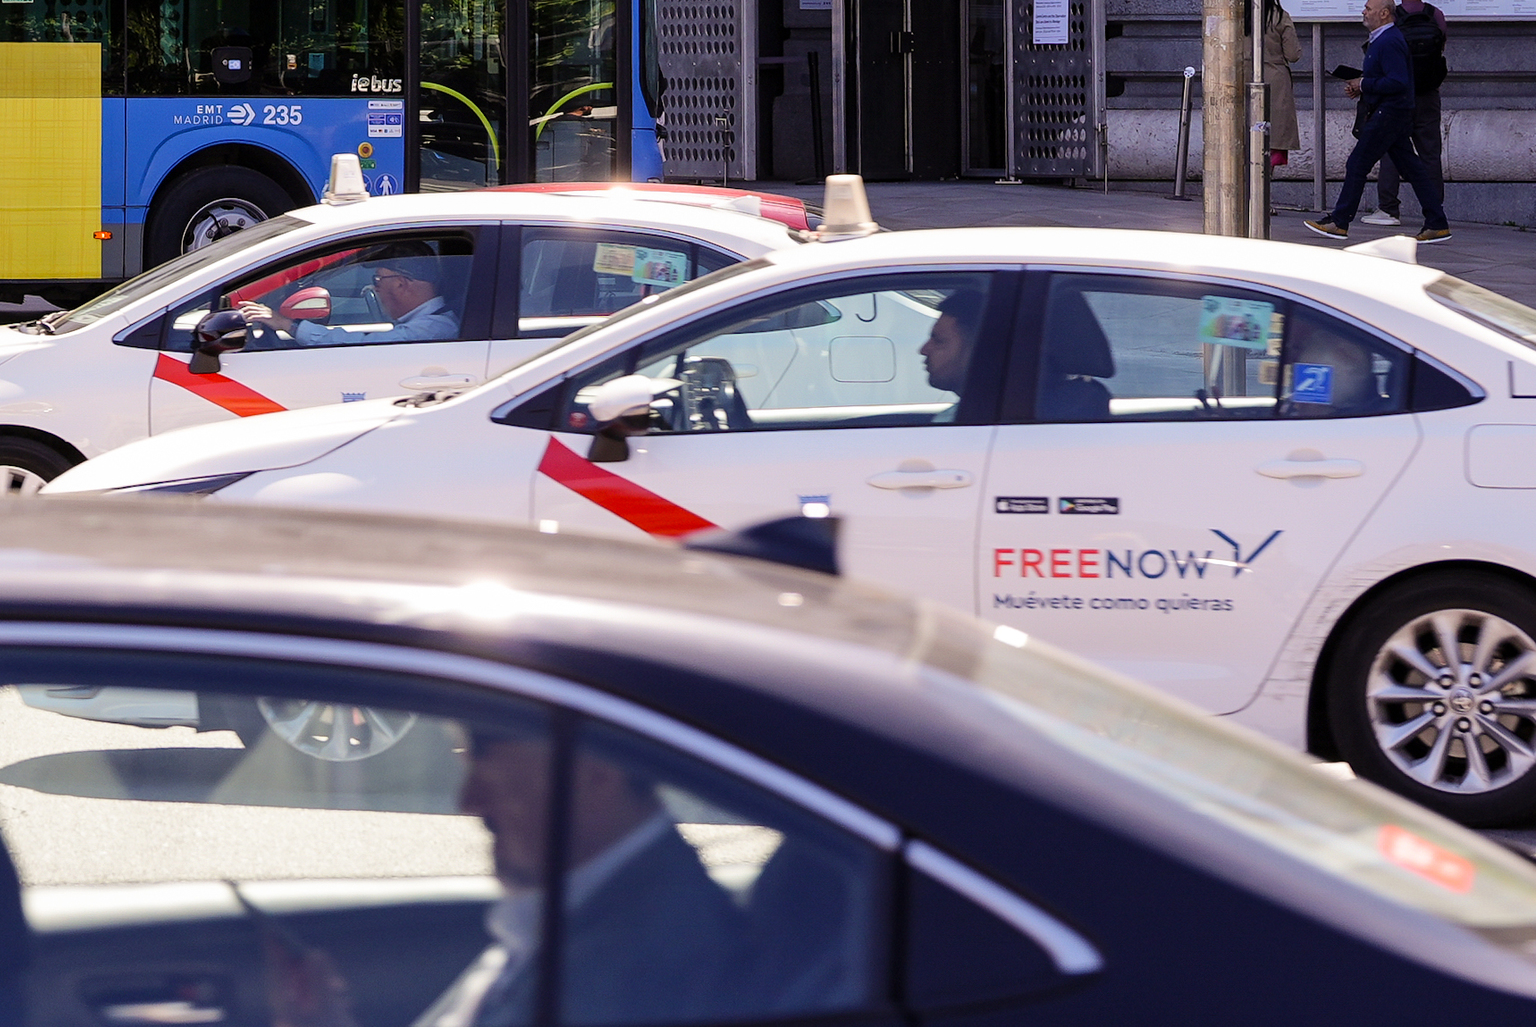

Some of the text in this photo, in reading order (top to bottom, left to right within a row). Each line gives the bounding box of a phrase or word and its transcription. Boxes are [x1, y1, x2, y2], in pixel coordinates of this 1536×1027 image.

[196, 105, 223, 114] EMT
[263, 105, 303, 125] 235
[173, 115, 223, 125] MADRID
[993, 591, 1233, 614] Muévete como quieras
